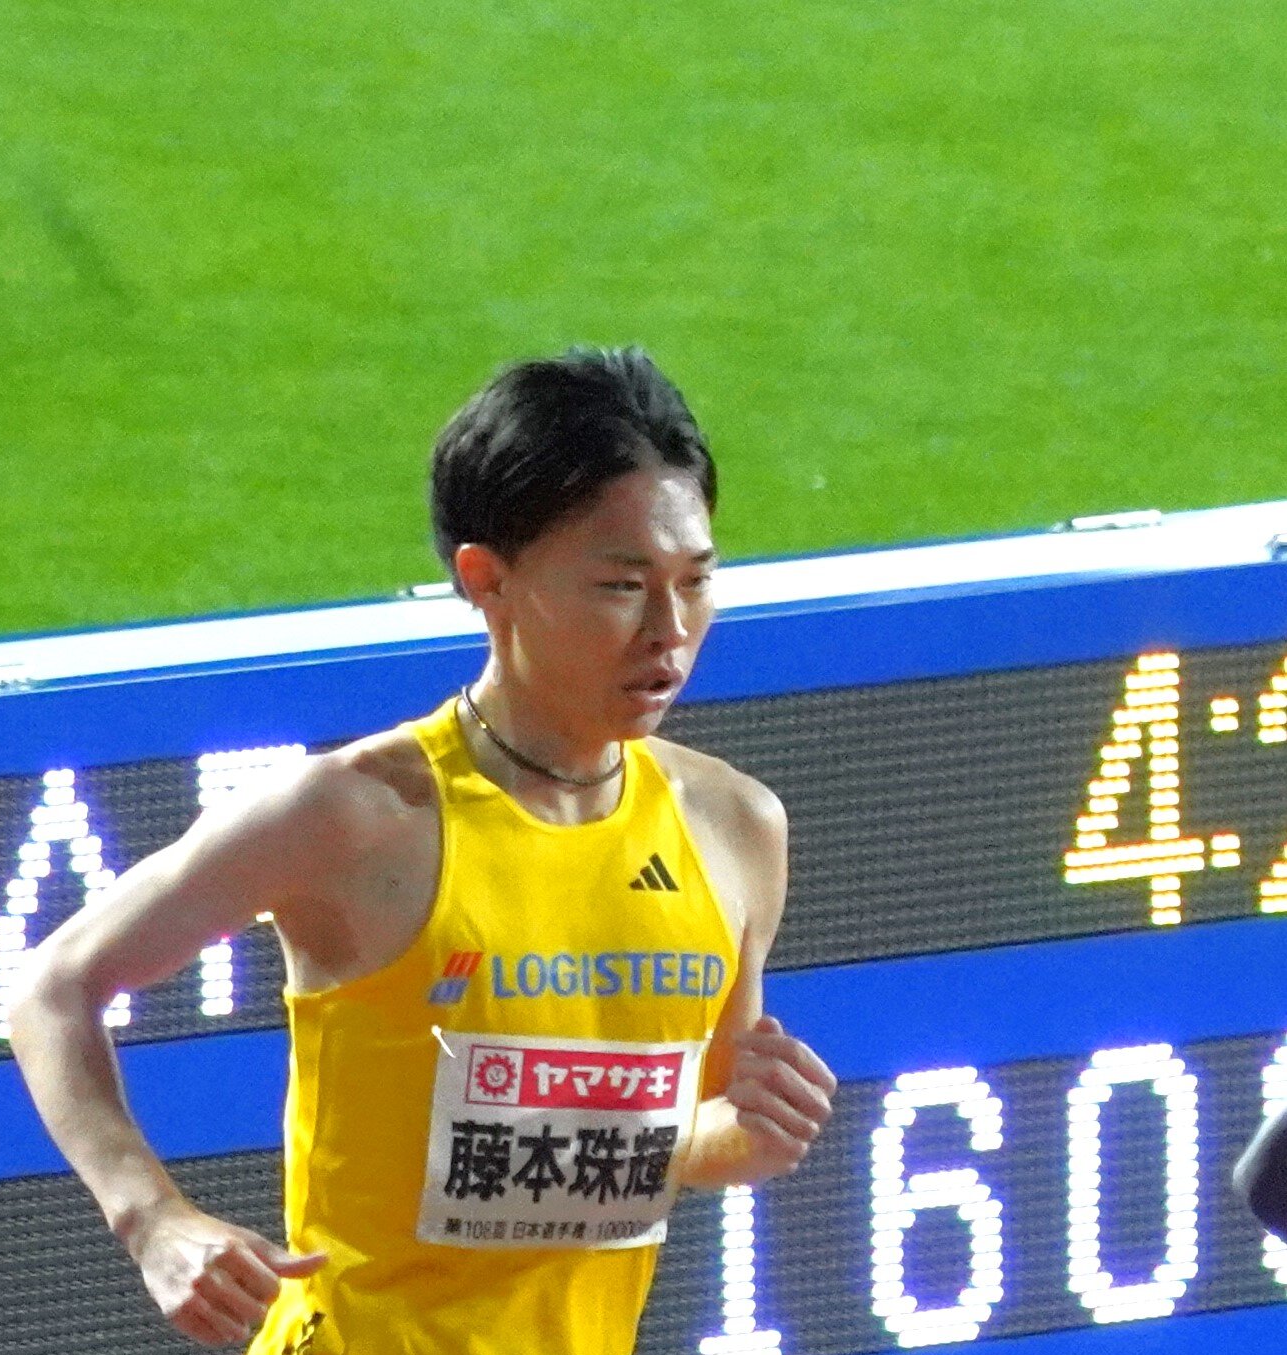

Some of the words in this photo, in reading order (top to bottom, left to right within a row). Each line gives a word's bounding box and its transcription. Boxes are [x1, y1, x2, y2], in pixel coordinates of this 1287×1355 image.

[491, 952, 726, 999] LOGISTEED
[444, 1121, 679, 1204] 藤本珠輝
